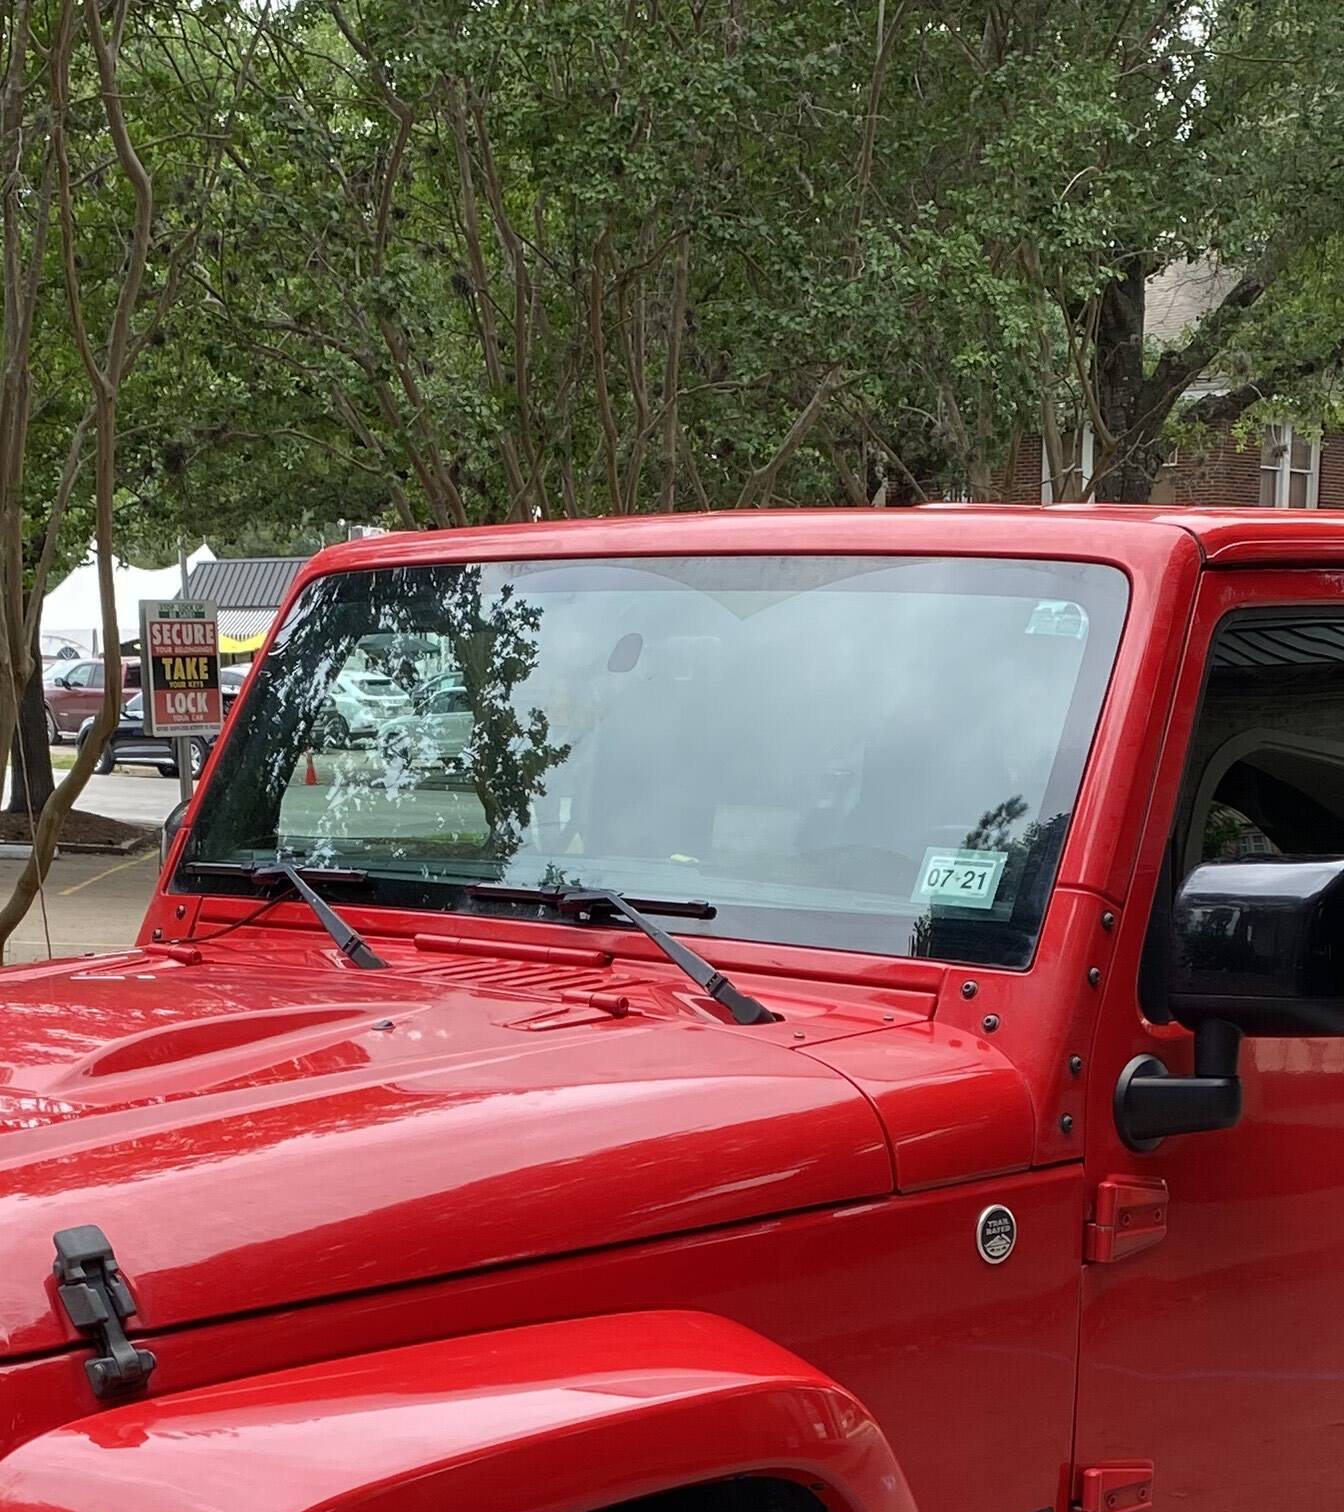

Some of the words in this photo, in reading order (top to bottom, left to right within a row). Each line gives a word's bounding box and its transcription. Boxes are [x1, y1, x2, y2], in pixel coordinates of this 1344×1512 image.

[152, 623, 215, 646] SECURE
[155, 646, 174, 654] YOUR
[162, 657, 209, 681] TAKE
[169, 681, 187, 689] YOUR
[166, 692, 209, 714] LOCK
[927, 867, 955, 888] 07
[960, 869, 987, 890] 21
[986, 1217, 1010, 1228] TRAIL
[985, 1226, 1011, 1236] RATED
